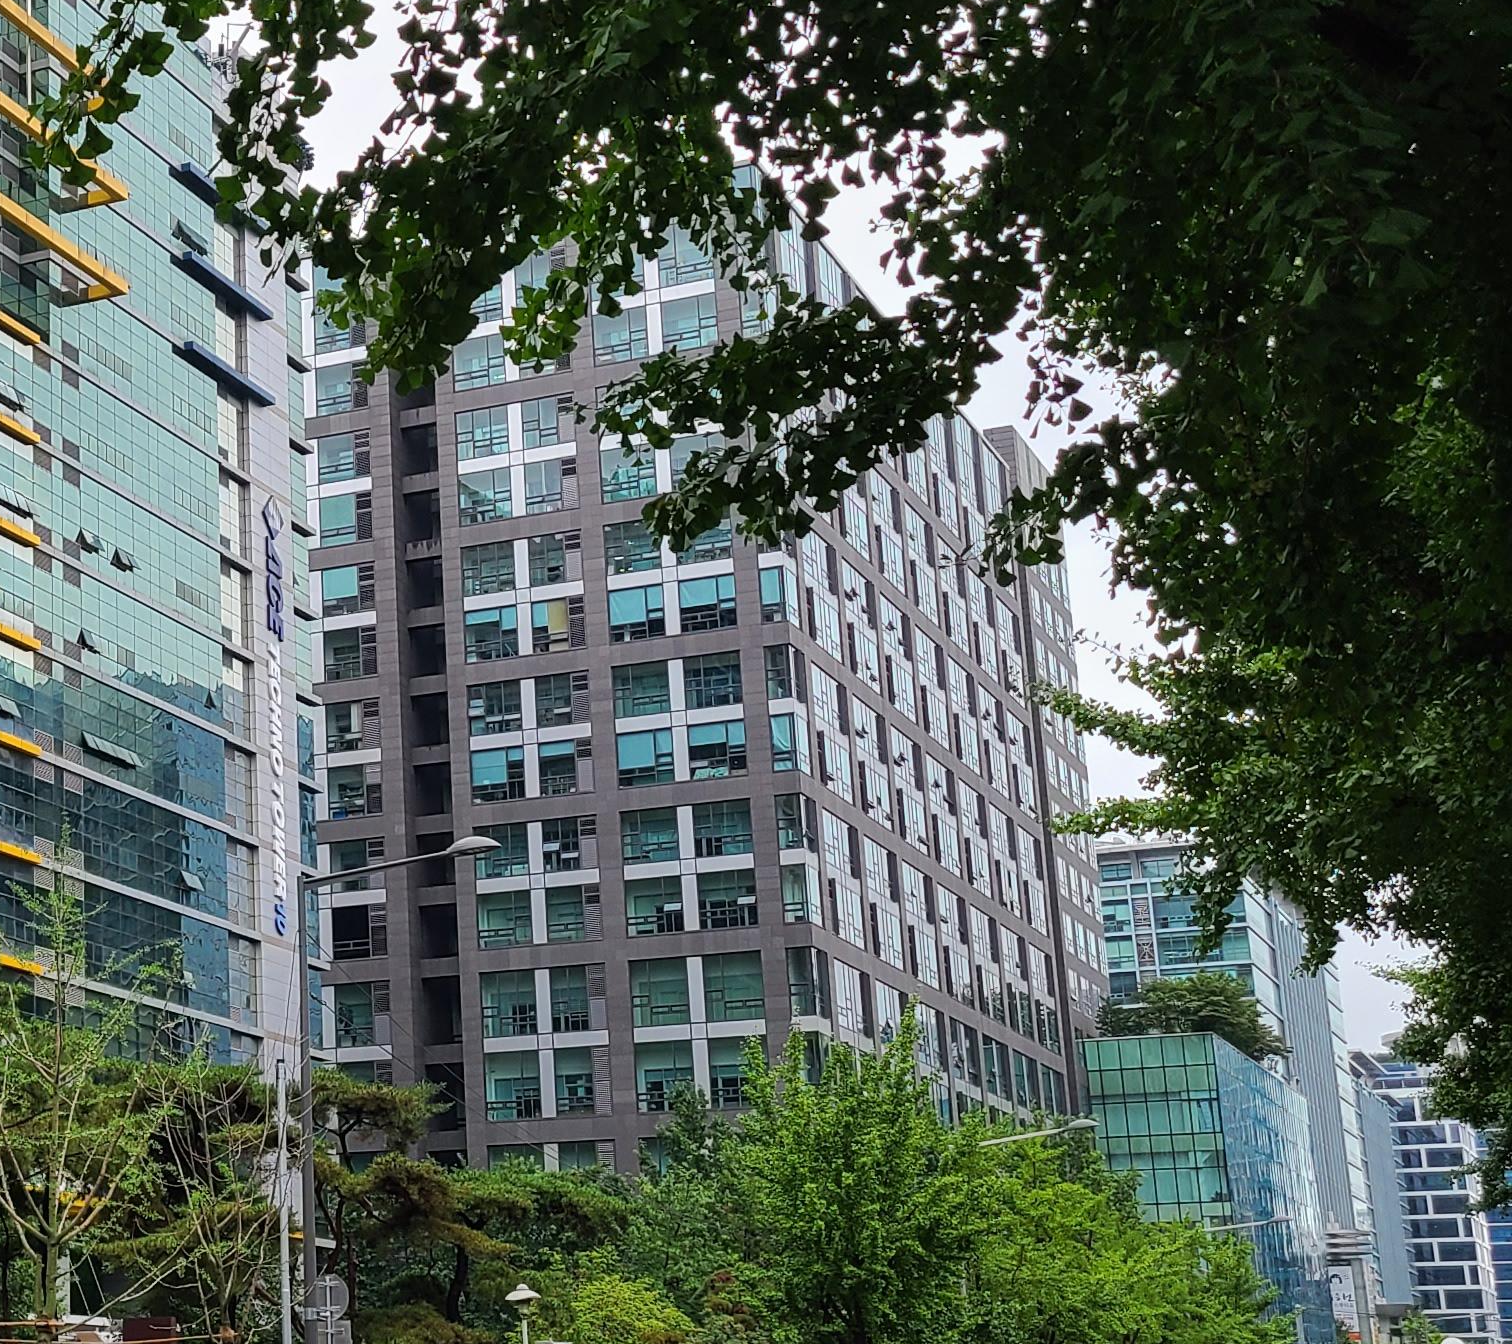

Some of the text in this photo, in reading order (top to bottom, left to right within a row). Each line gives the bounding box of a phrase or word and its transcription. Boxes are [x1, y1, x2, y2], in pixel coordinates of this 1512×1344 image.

[265, 536, 284, 642] ACE
[267, 643, 284, 777] TECHNO
[271, 781, 287, 901] TOWER
